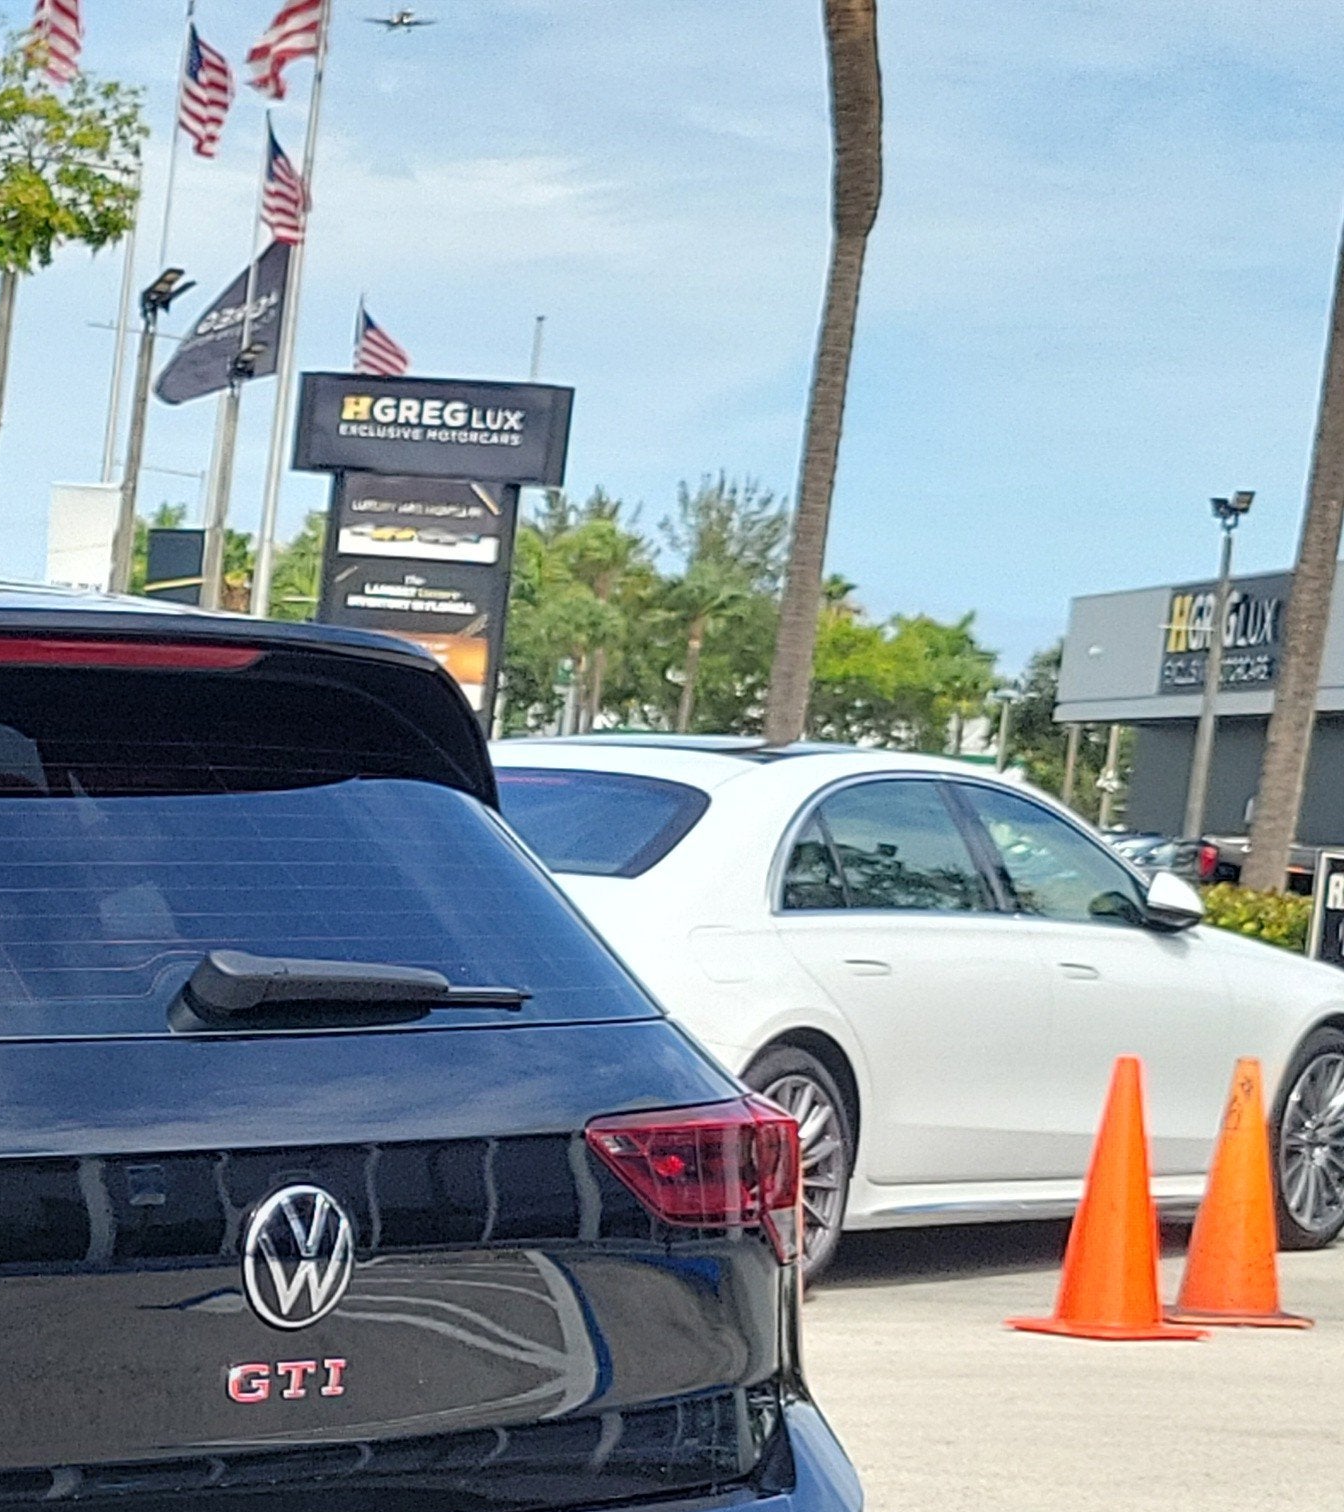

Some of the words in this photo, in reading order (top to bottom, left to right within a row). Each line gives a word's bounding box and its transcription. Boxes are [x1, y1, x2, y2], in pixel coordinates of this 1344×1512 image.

[338, 423, 422, 441] EXCLUSIVE
[426, 429, 522, 447] MOTORCARS
[227, 1358, 347, 1403] GTI
